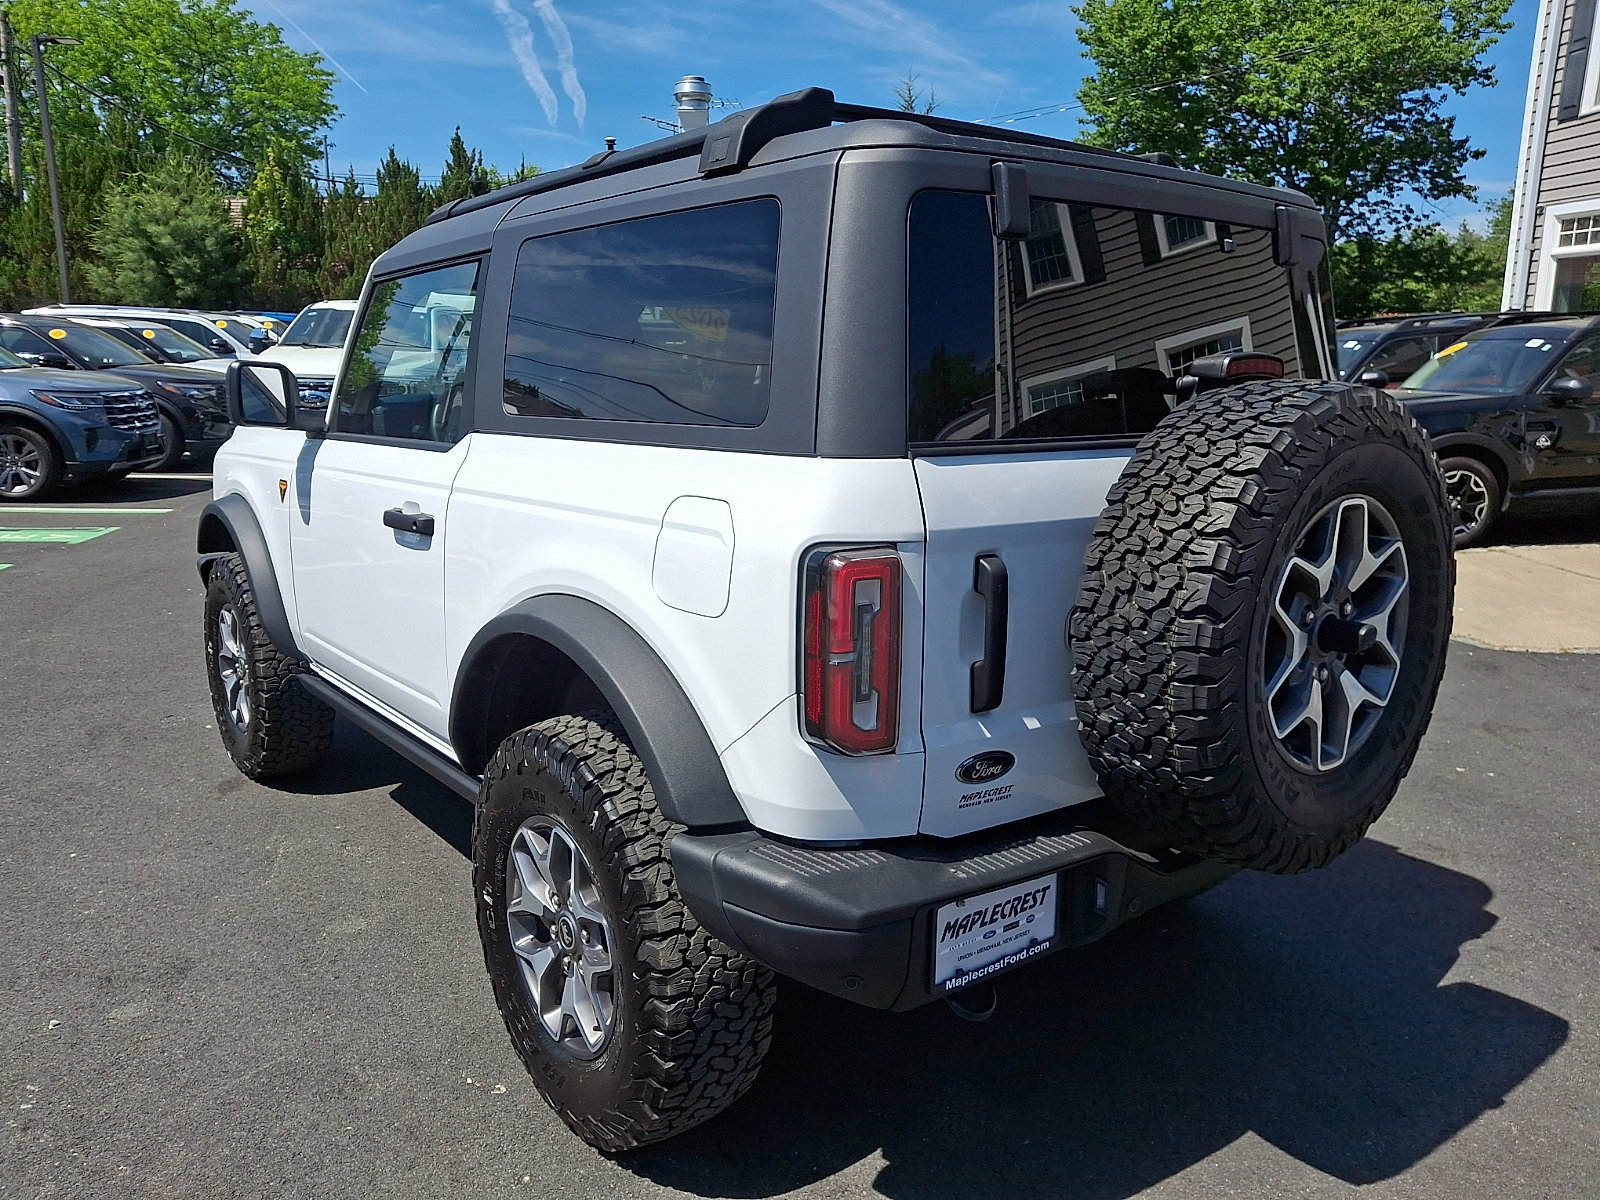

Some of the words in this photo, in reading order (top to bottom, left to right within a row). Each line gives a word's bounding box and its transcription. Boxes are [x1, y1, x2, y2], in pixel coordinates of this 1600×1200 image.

[972, 760, 1003, 779] Ford
[959, 785, 1014, 803] MAPLECREST
[940, 885, 1051, 943] MAPLECREST
[957, 952, 974, 962] UNION
[1014, 929, 1031, 940] JERSEY
[945, 941, 1050, 991] MaplecrestFord.com
